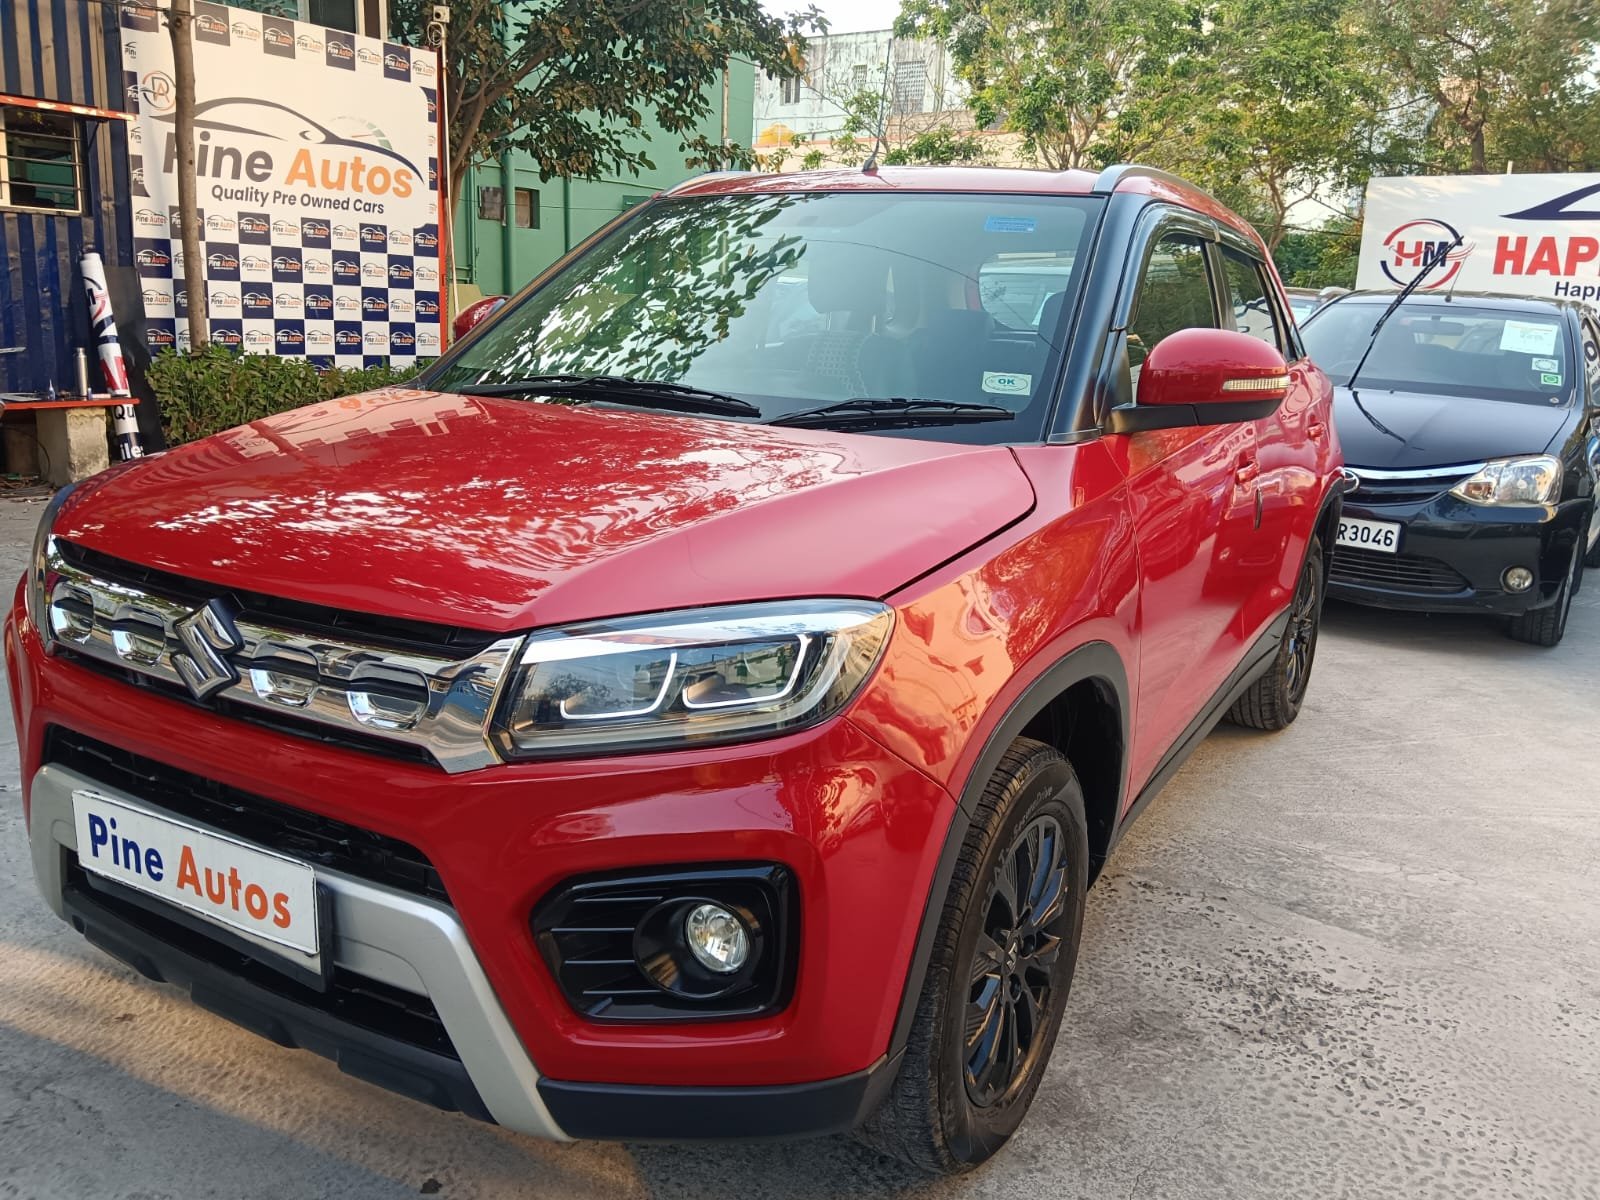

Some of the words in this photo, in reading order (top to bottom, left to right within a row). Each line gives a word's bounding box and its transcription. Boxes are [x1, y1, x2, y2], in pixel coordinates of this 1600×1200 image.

[284, 148, 413, 198] Autos
[212, 185, 269, 207] Quality
[272, 191, 296, 206] Pre
[301, 193, 350, 211] Owned
[353, 198, 385, 214] Cars
[1394, 240, 1449, 267] HM
[1493, 236, 1600, 276] HAP
[1338, 523, 1395, 547] R3046
[88, 813, 164, 882] Pine
[176, 845, 291, 929] Autos
